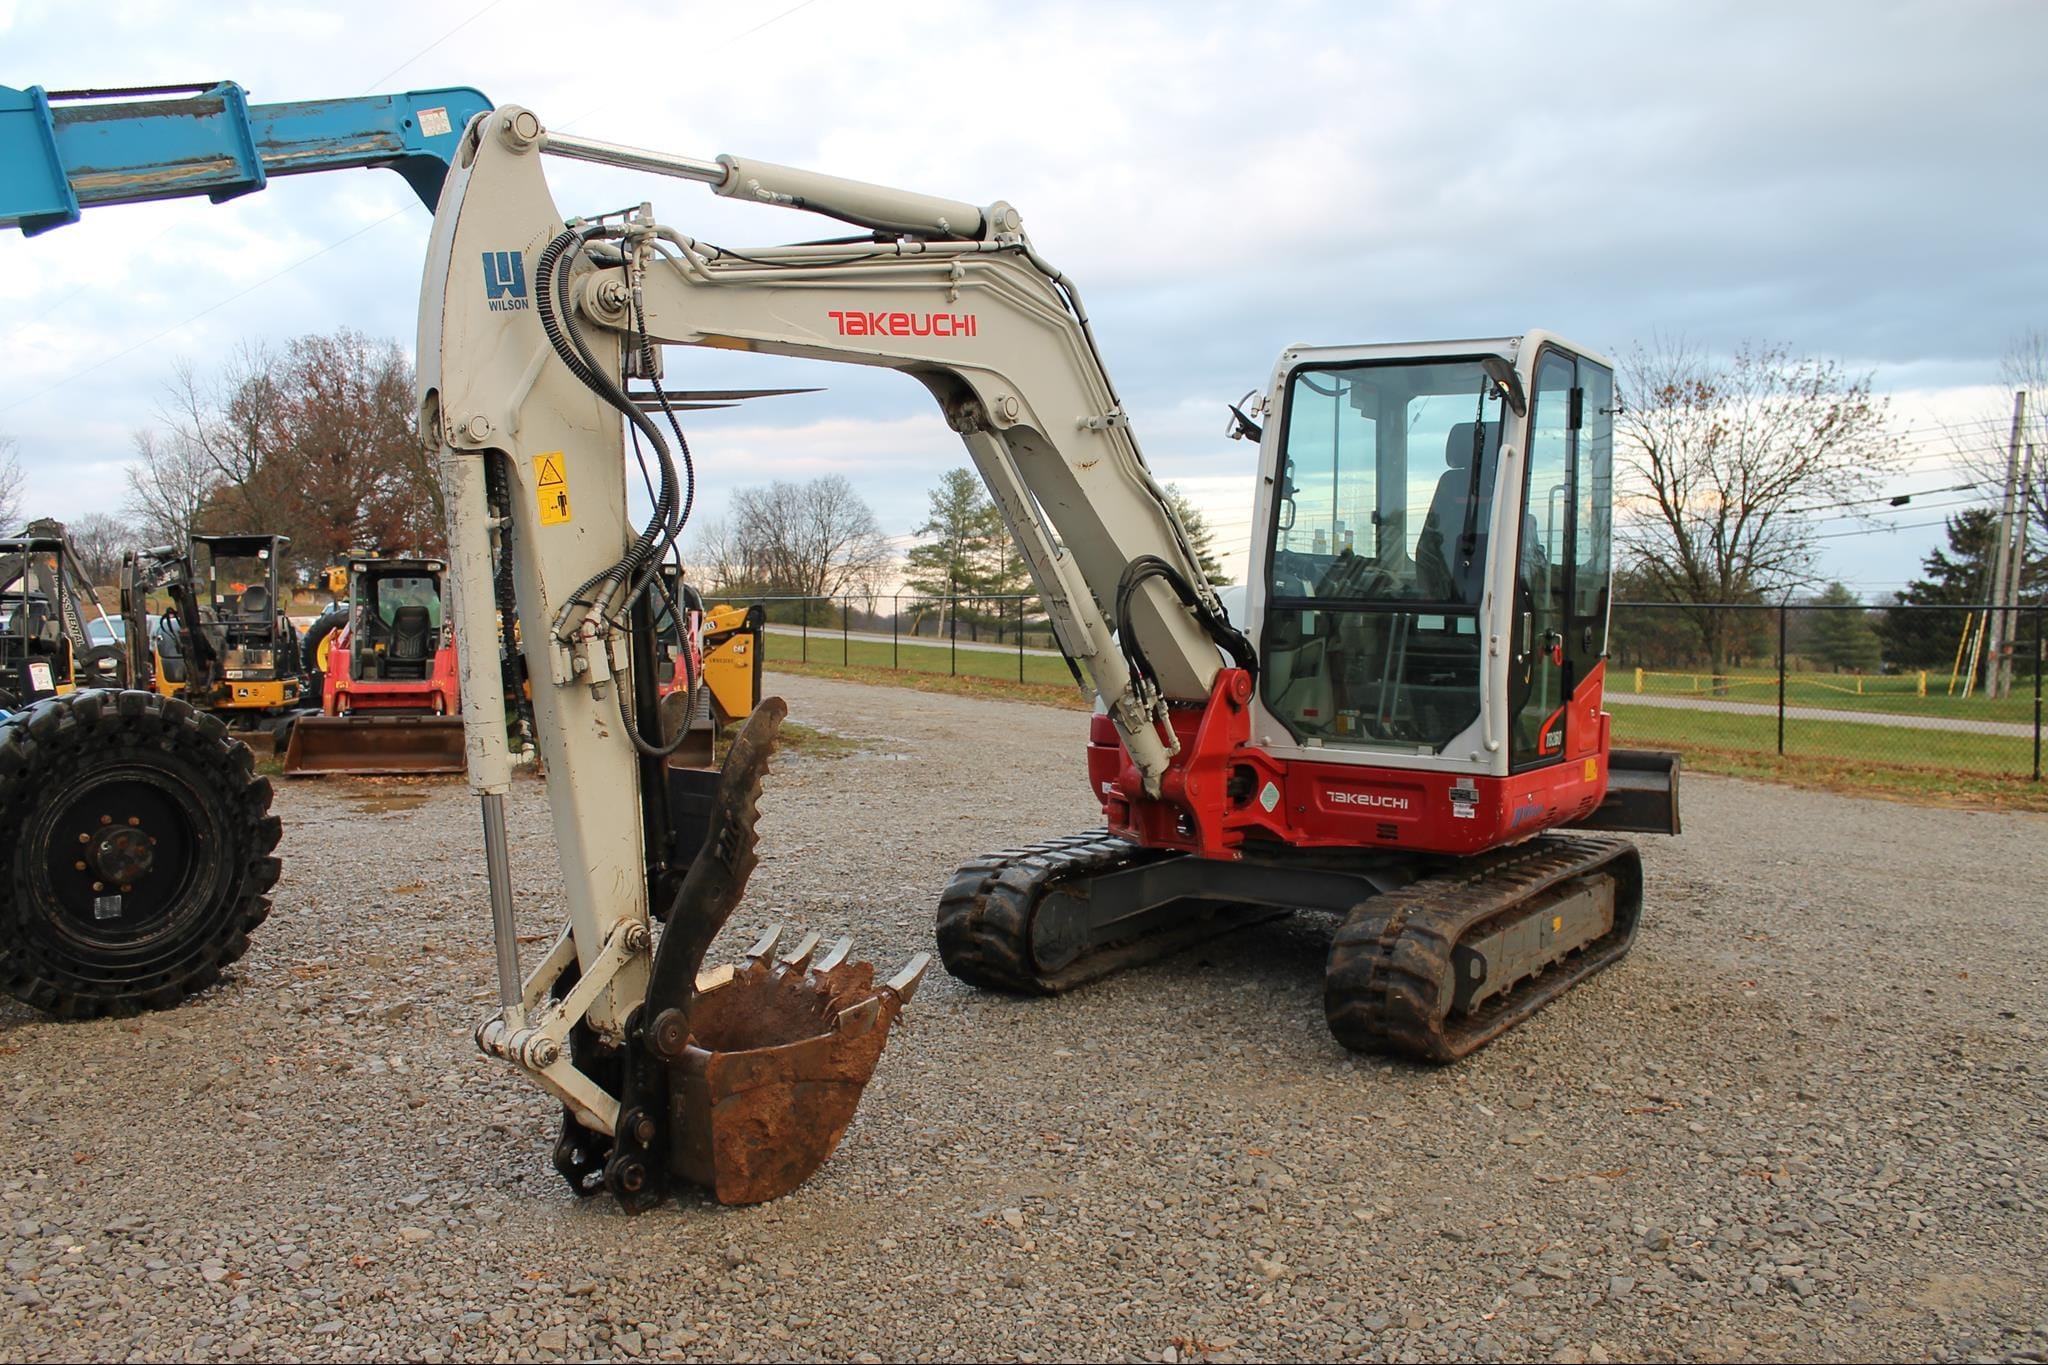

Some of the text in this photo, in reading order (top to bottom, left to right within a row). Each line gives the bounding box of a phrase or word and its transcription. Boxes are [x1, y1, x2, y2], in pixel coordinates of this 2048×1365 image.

[488, 299, 529, 312] WILSON
[828, 311, 977, 337] TAKEUCHI
[64, 611, 85, 648] RENTAL
[1326, 791, 1409, 810] TAKEUCHI
